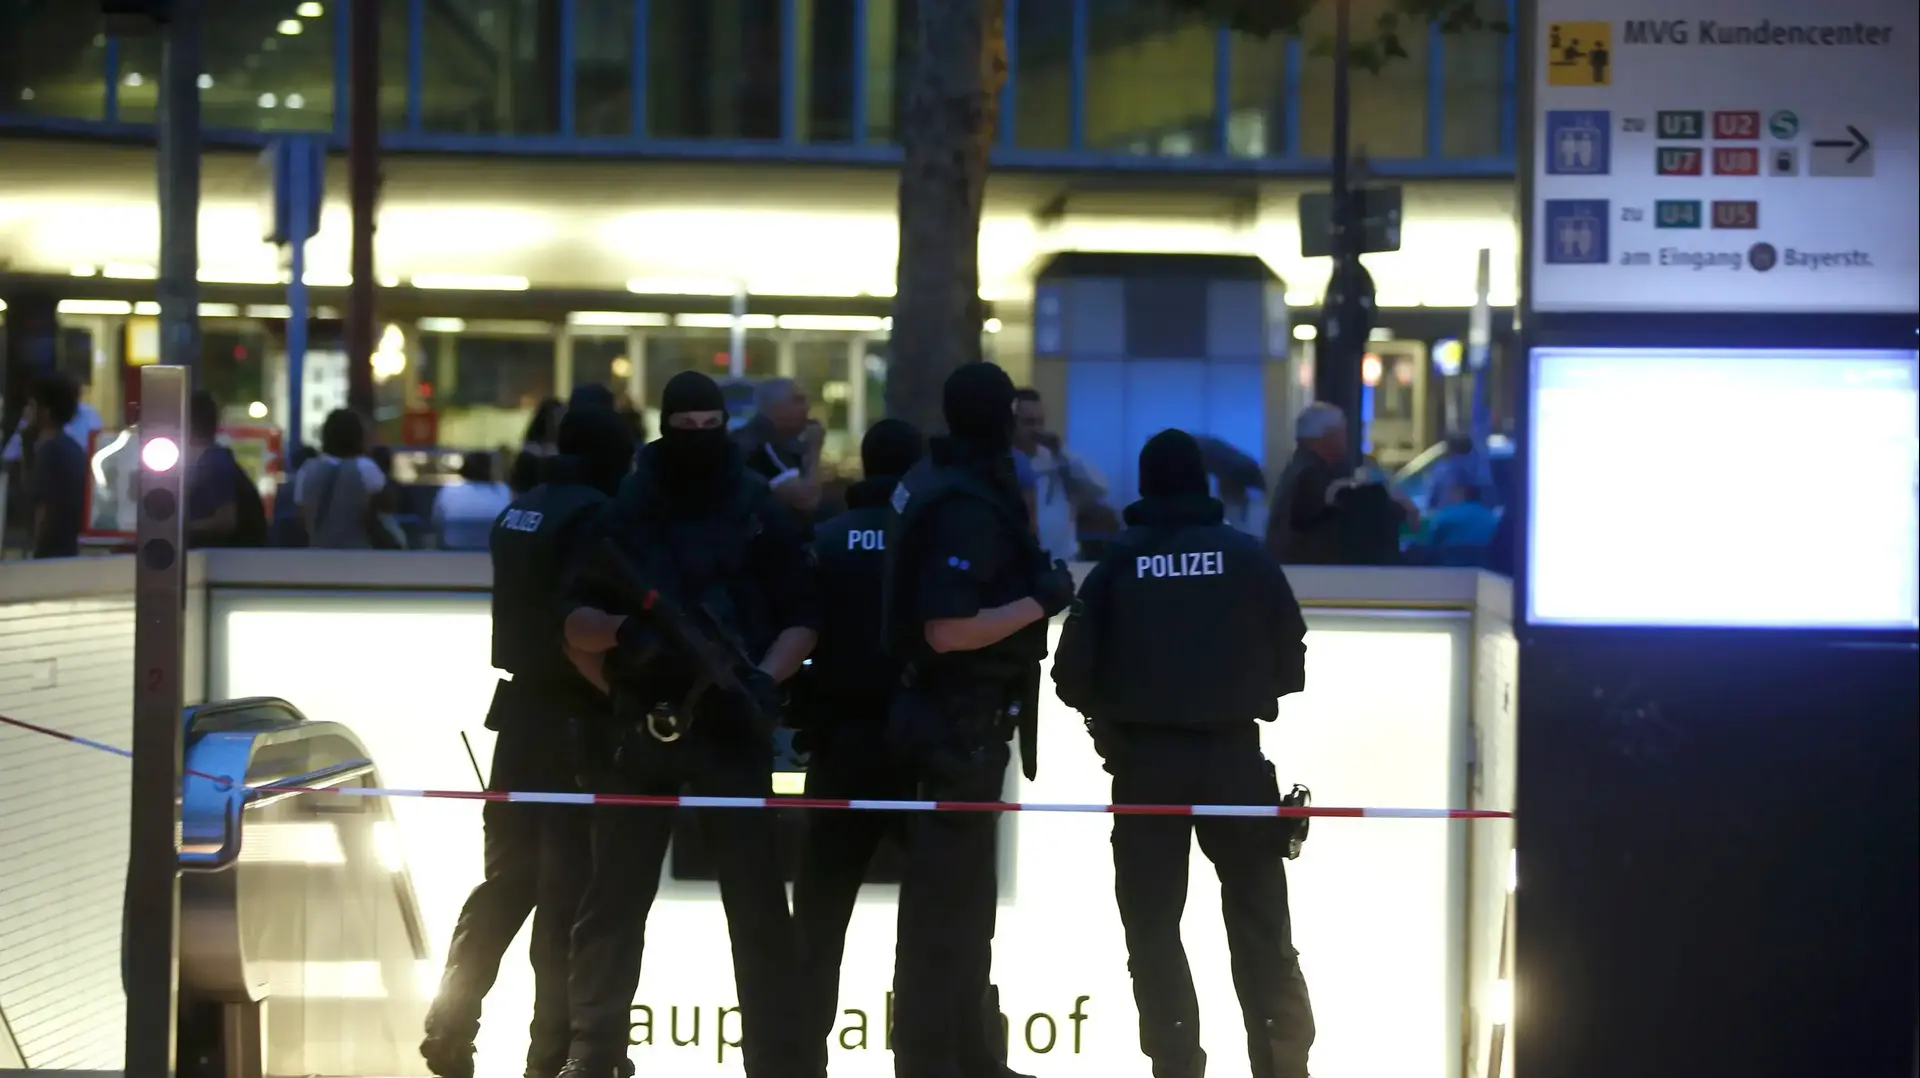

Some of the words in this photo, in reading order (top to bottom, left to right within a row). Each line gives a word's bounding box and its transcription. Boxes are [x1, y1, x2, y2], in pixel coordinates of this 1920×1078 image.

[1624, 20, 1689, 45] MVG
[1699, 19, 1893, 46] Kundencenter
[1621, 117, 1646, 133] zu
[1663, 114, 1697, 135] U1
[1719, 114, 1753, 135] U2
[1662, 151, 1697, 171] U7
[1620, 206, 1644, 222] zu
[1661, 204, 1695, 224] U4
[1717, 204, 1752, 224] U5
[1620, 251, 1651, 266] am
[1659, 247, 1742, 270] Eingang
[1783, 248, 1875, 270] Bayerstr.
[1136, 551, 1224, 579] POLIZEI
